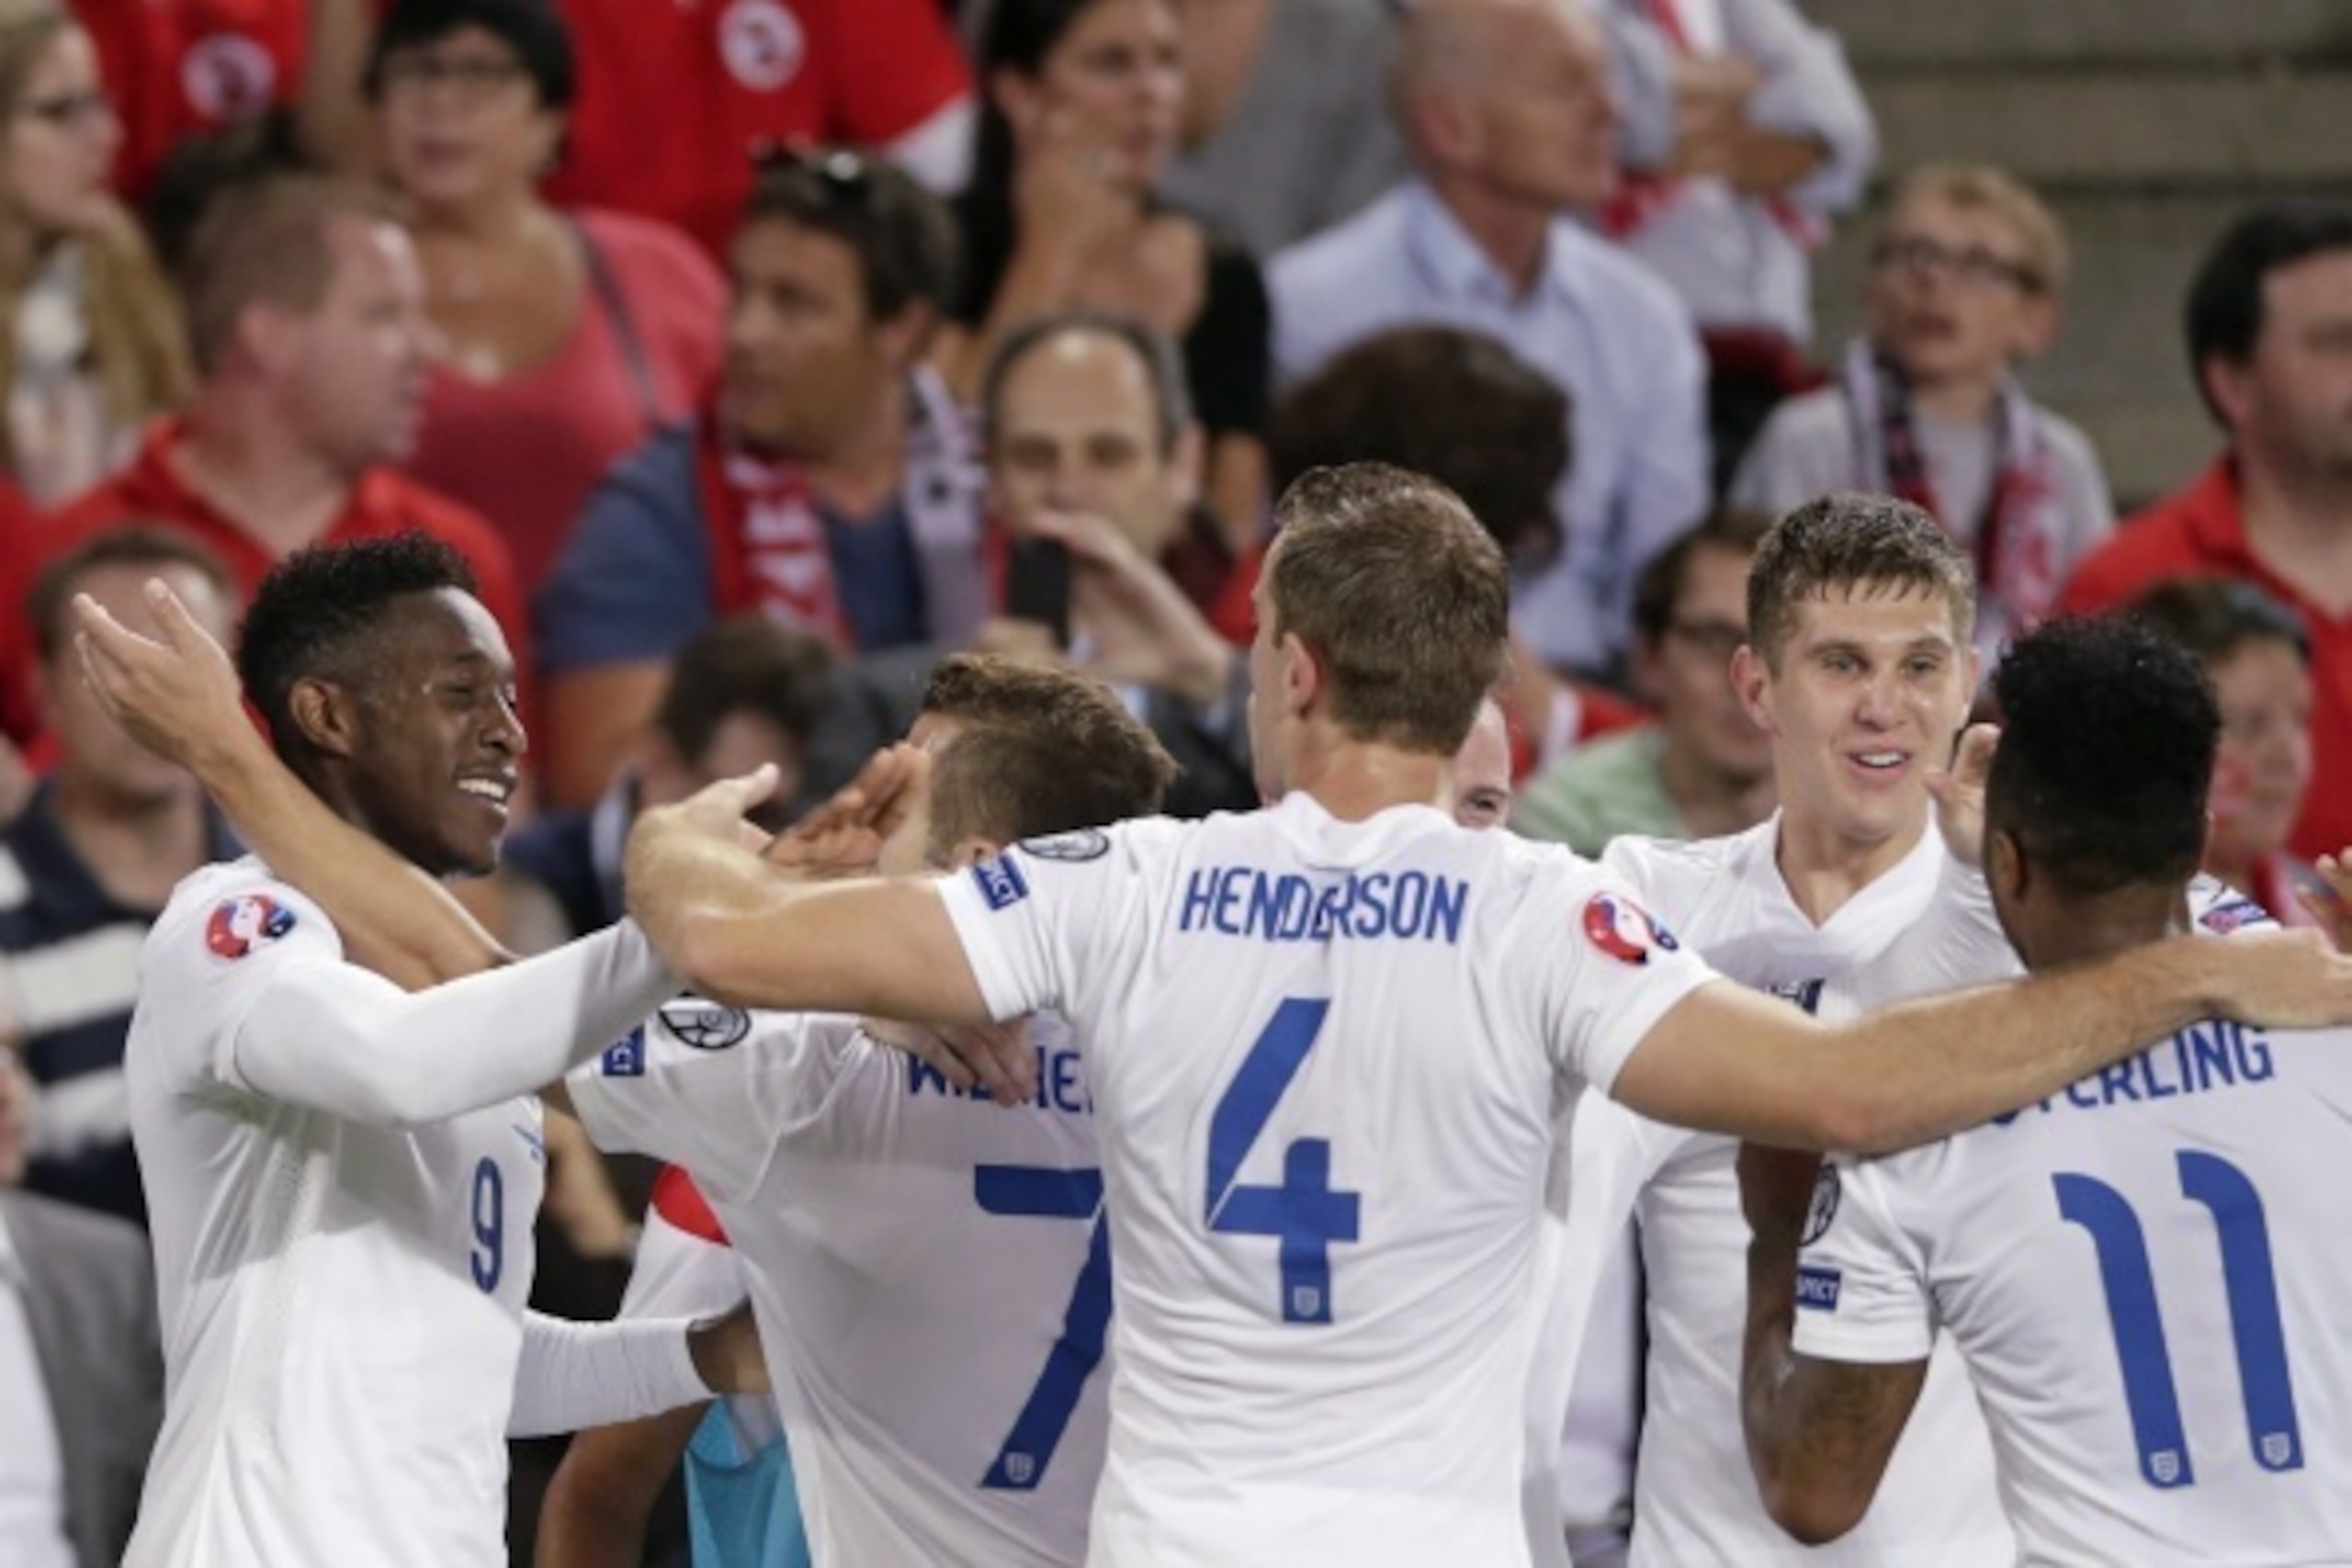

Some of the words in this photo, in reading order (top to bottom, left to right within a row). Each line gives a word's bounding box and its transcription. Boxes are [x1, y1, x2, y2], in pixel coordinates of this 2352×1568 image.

[1179, 866, 1469, 944] HENDERSON
[470, 1156, 503, 1293] 9
[1204, 997, 1361, 1324] 4
[2052, 1148, 2304, 1489] 11
[974, 1164, 1114, 1491] 7
